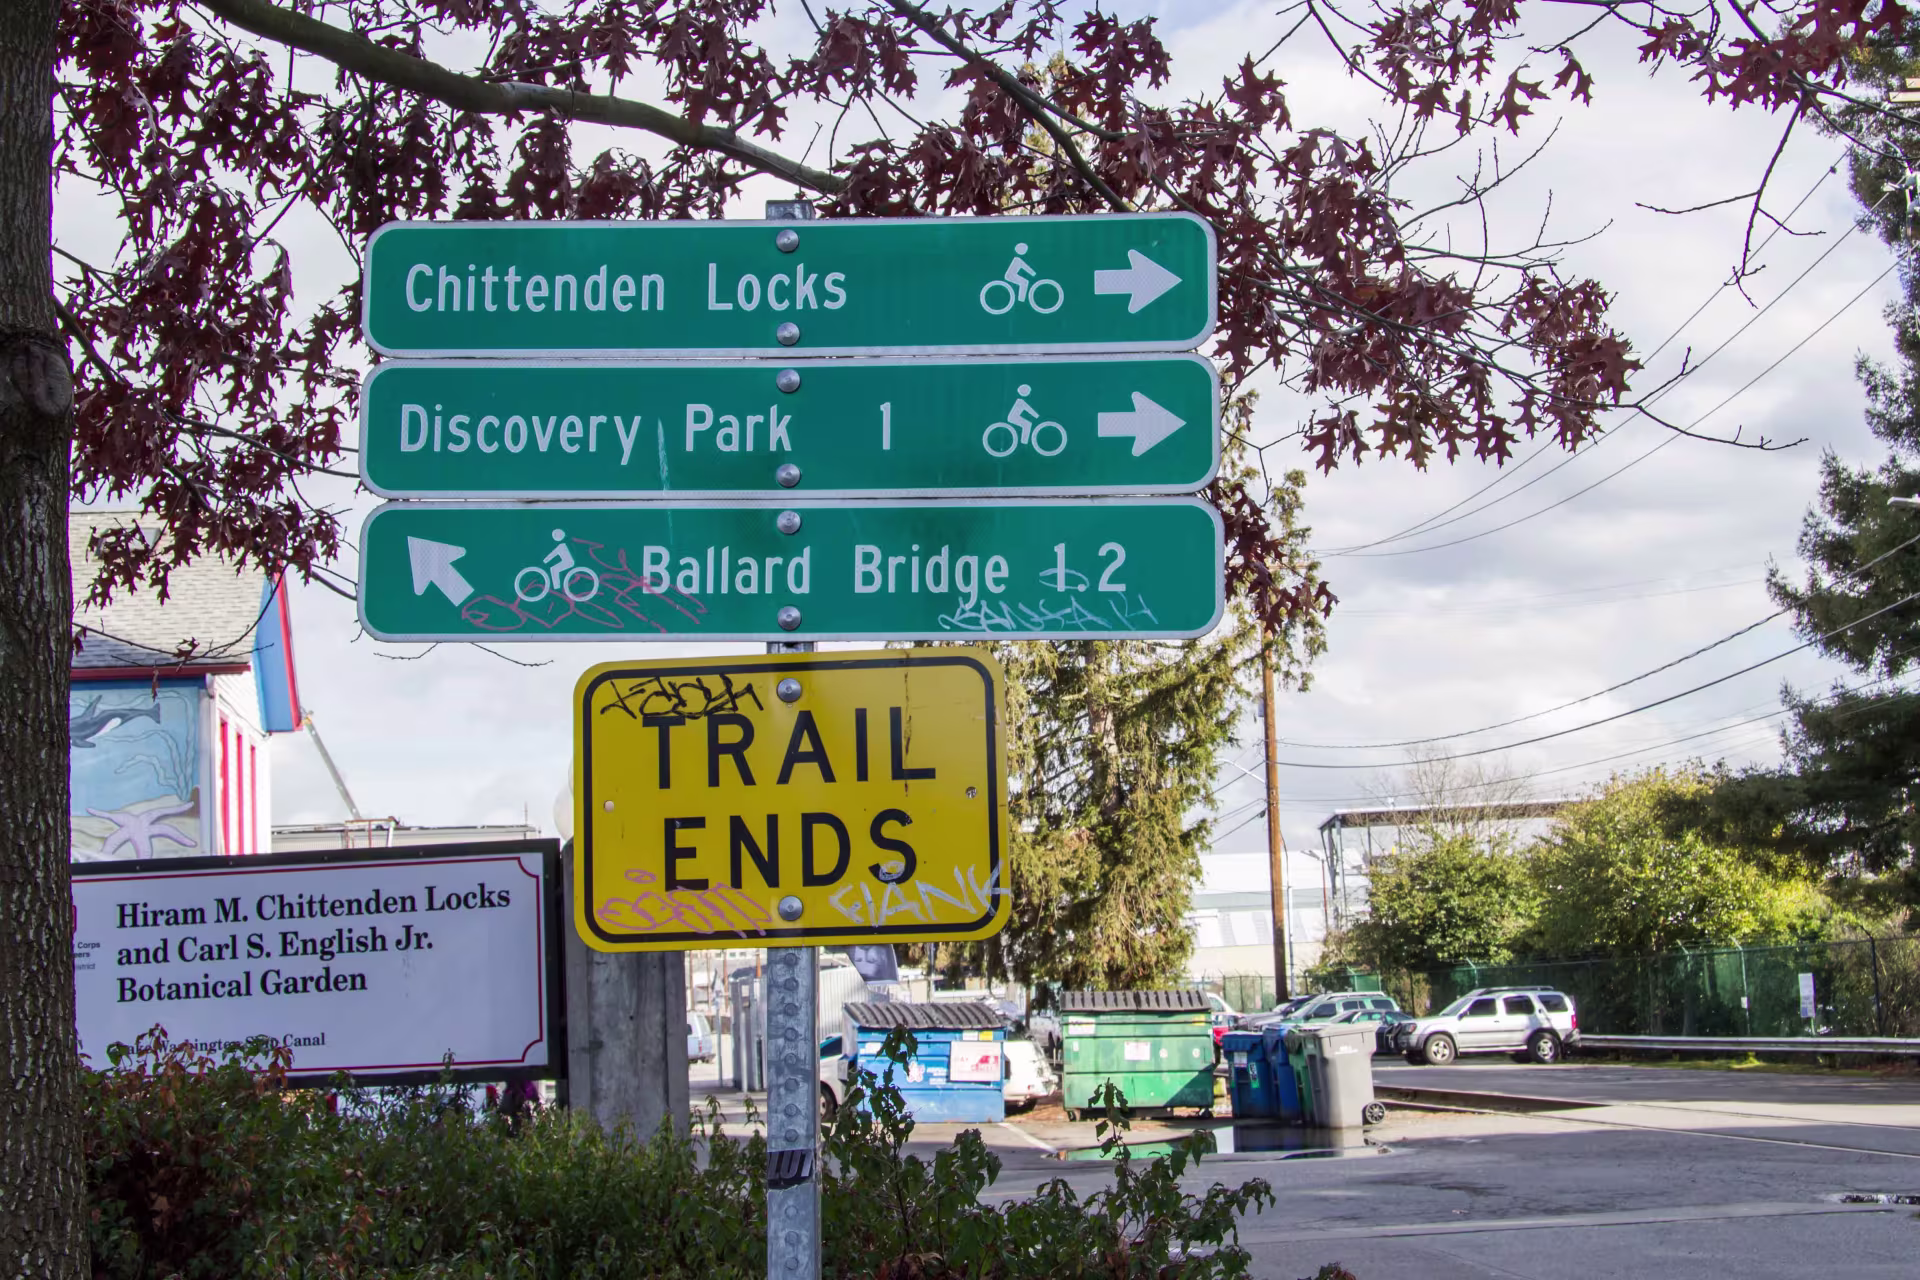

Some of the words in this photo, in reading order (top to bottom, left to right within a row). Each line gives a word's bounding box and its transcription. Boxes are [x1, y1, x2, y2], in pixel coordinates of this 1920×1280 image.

[406, 264, 665, 312] Chittenden
[708, 263, 846, 311] Locks
[400, 404, 641, 465] Discovery
[685, 404, 793, 452] Park
[879, 402, 891, 450] 1
[642, 545, 811, 595] Ballard
[854, 543, 1009, 609] Bridge
[1053, 542, 1126, 592] 1.2
[642, 706, 936, 789] TRAIL
[664, 808, 917, 891] ENDS
[116, 902, 207, 928] Hiram
[214, 897, 248, 923] M.
[256, 889, 417, 922] Chittenden
[425, 882, 511, 912] Locks
[78, 941, 101, 950] Corps
[117, 938, 170, 966] and
[178, 934, 239, 963] Carl
[247, 933, 271, 960] S.
[279, 926, 388, 962] English
[395, 924, 433, 951] Jr.
[117, 971, 253, 1003] Botanical
[260, 965, 368, 997] Garden
[283, 1032, 325, 1047] Canal
